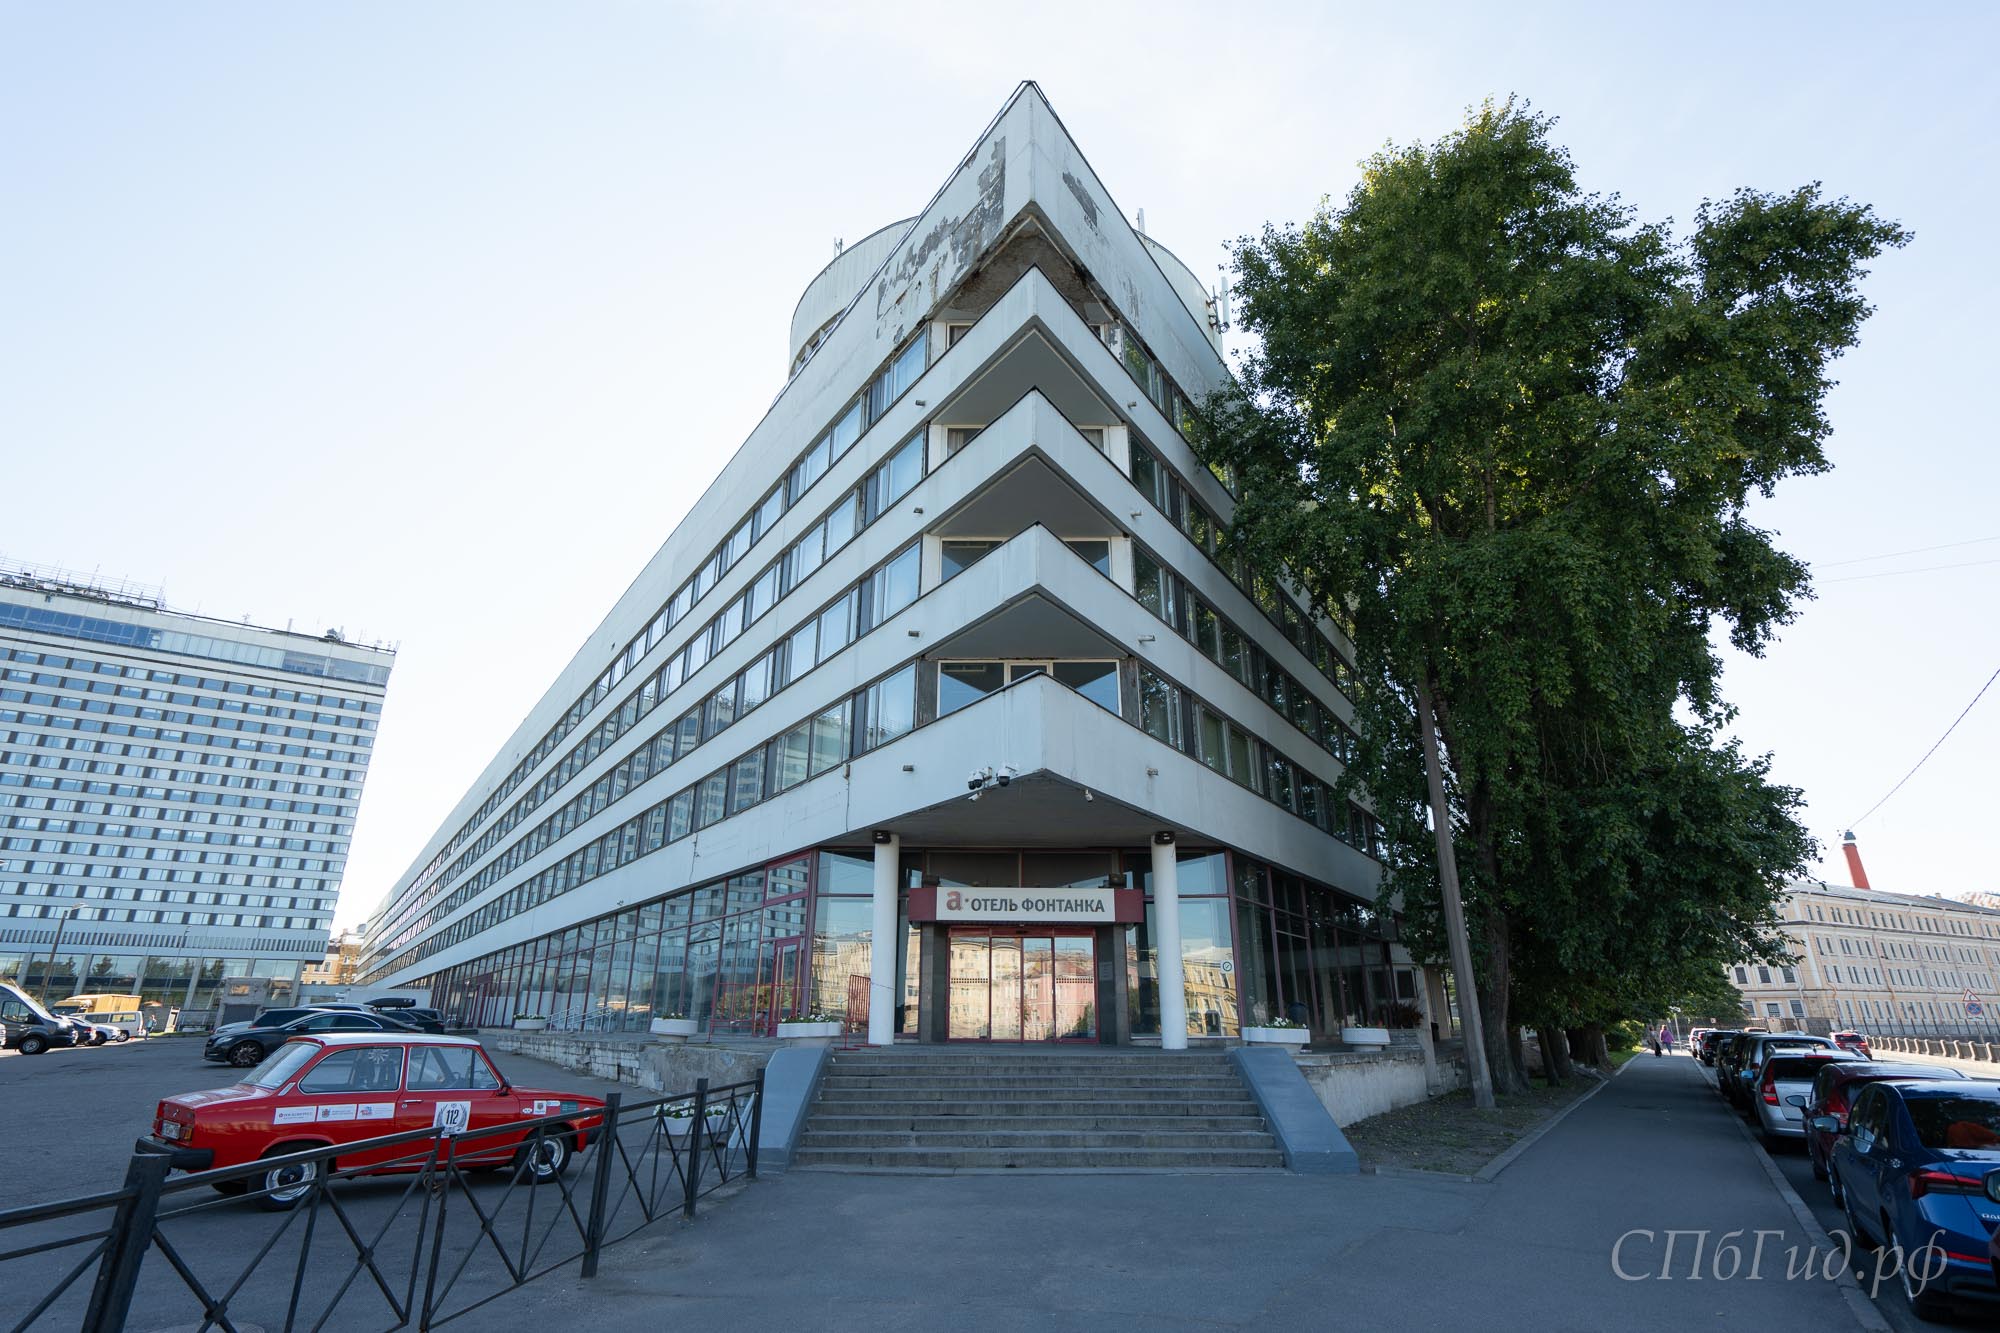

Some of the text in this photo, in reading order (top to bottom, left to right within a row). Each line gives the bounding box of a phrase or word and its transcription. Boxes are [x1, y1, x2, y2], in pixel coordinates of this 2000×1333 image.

[971, 898, 1018, 912] ОТЕЛЬ
[1022, 898, 1105, 913] ФОНТАНКА
[446, 1109, 460, 1125] 112
